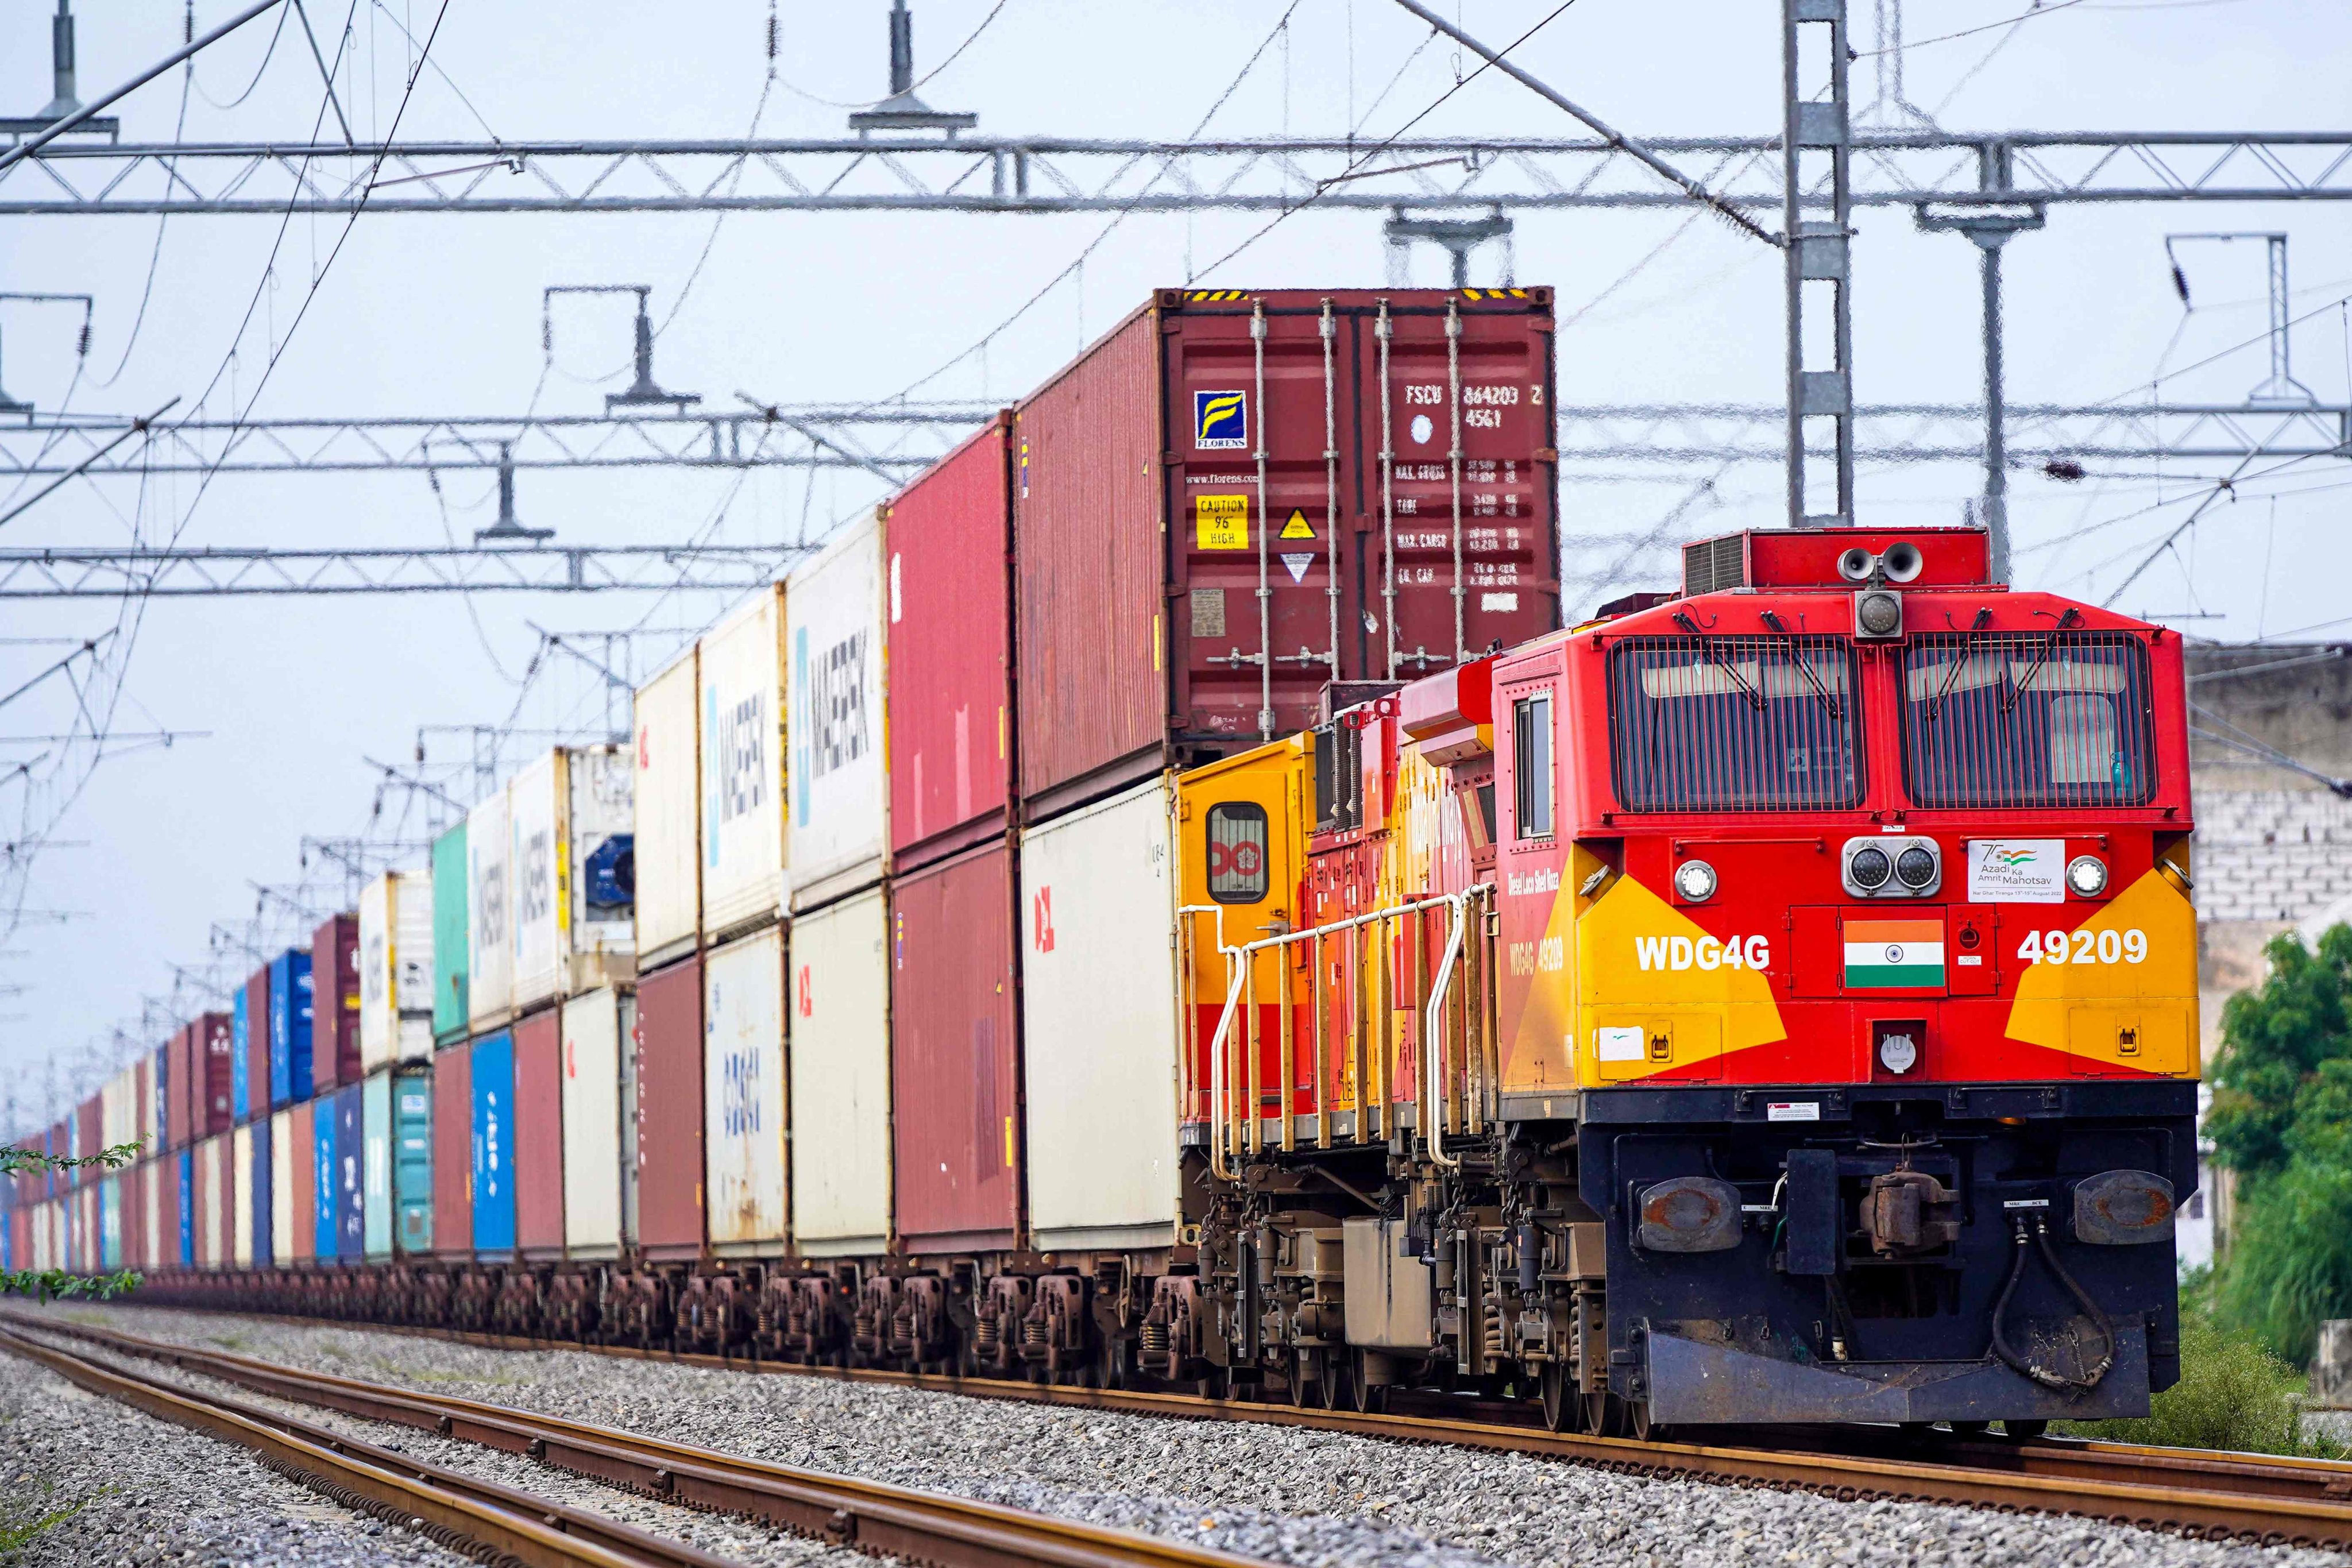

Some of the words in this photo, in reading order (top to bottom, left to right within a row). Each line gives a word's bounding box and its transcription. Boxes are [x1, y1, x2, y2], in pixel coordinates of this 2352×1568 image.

[1405, 385, 1442, 404] FSCU
[1530, 384, 1544, 405] 2
[1198, 439, 1245, 447] FLORENS
[1201, 500, 1244, 512] CAUTION
[1211, 532, 1235, 544] HIGH
[1982, 864, 2010, 872] Azadi
[1508, 871, 1522, 896] Diesel
[1523, 871, 1534, 894] Loco
[1535, 868, 1546, 893] Shed
[1547, 867, 1559, 891] Roza
[2003, 876, 2052, 885] Mahotsav
[1635, 934, 1770, 971] WDG4G
[2017, 929, 2148, 964] 49209
[1509, 941, 1534, 976] WDG4G
[1538, 936, 1563, 972] 49209
